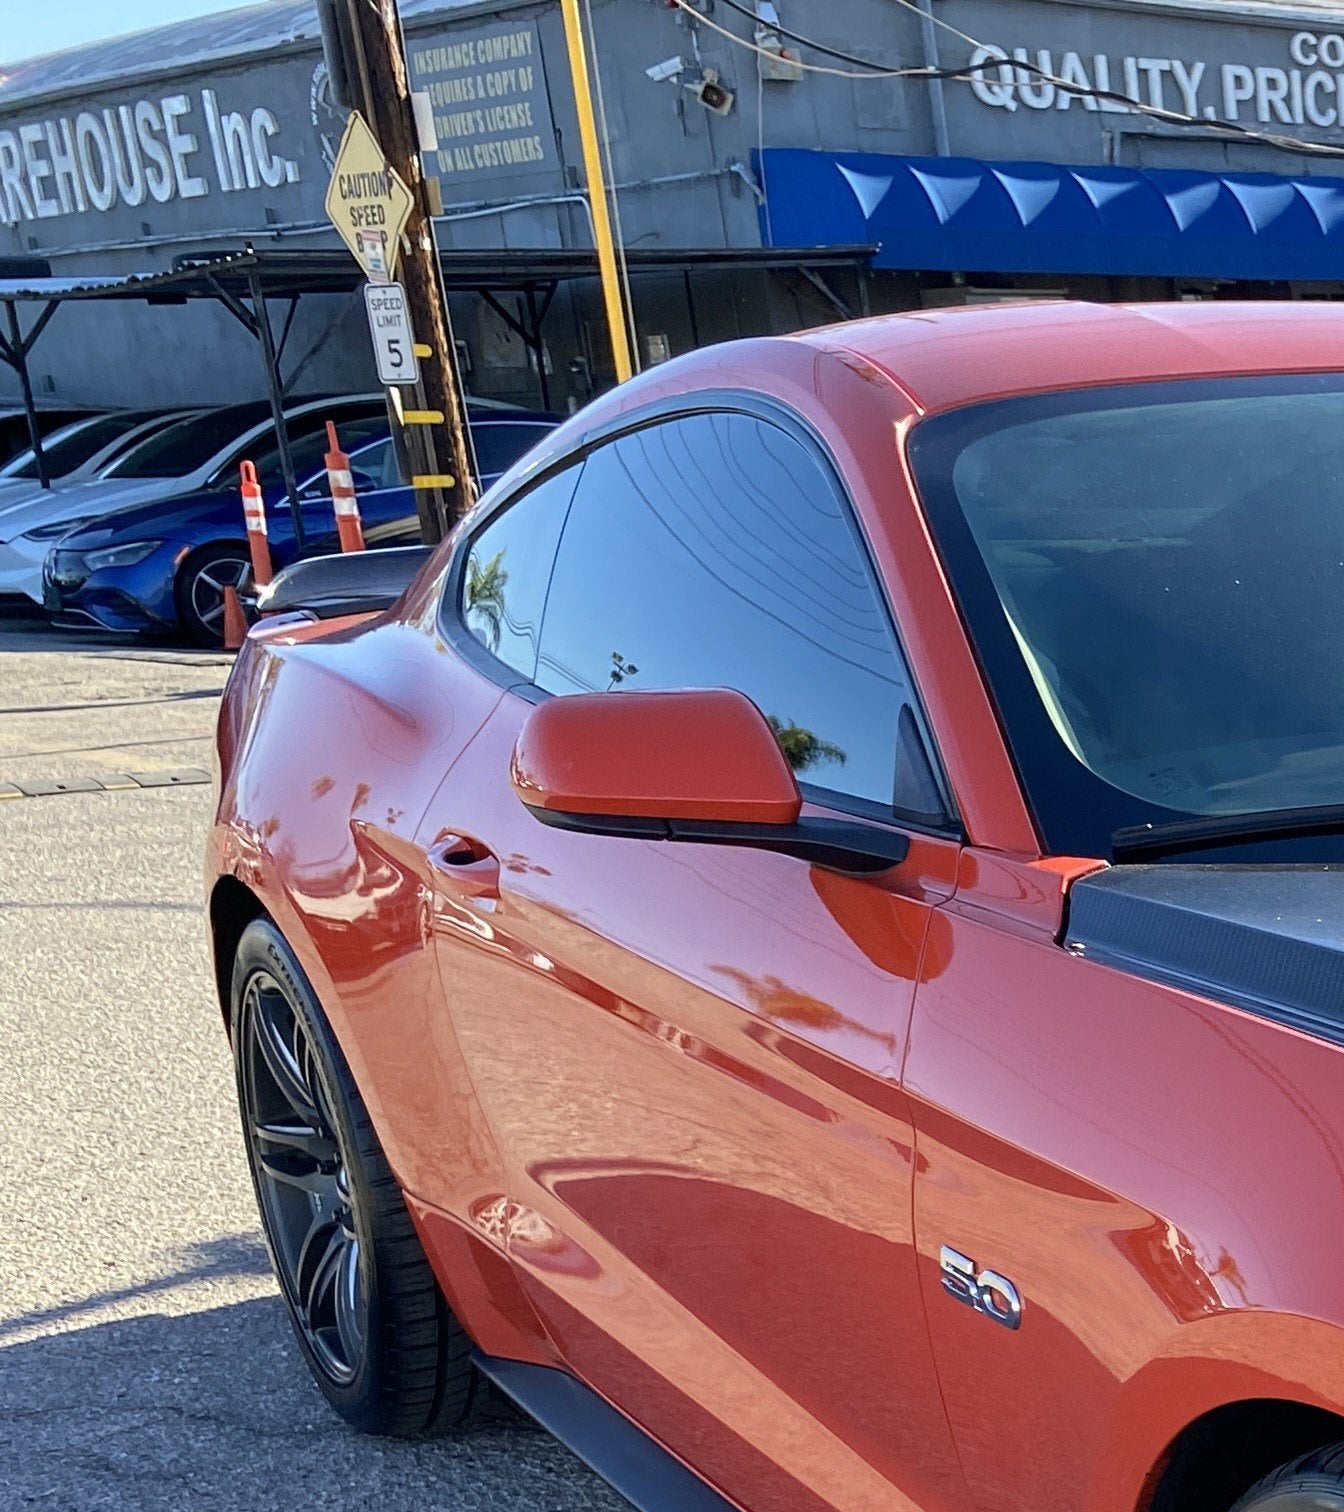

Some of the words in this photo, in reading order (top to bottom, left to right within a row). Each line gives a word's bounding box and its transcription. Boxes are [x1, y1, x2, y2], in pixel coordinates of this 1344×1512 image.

[414, 41, 476, 75] INSURANCE
[477, 31, 532, 64] COMPANY
[477, 75, 486, 99] A
[486, 69, 517, 97] COPY
[519, 66, 534, 92] OF
[485, 102, 534, 132] LICENSE
[201, 89, 300, 193] Inc.
[437, 148, 455, 173] ON
[454, 146, 475, 170] ALL
[474, 135, 544, 168] CUSTOMERS
[338, 170, 388, 199] CAUTION
[350, 204, 385, 228] SPEED
[356, 230, 388, 253] BP
[371, 297, 403, 311] SPEED
[376, 314, 402, 328] LIMIT
[387, 339, 404, 368] 5
